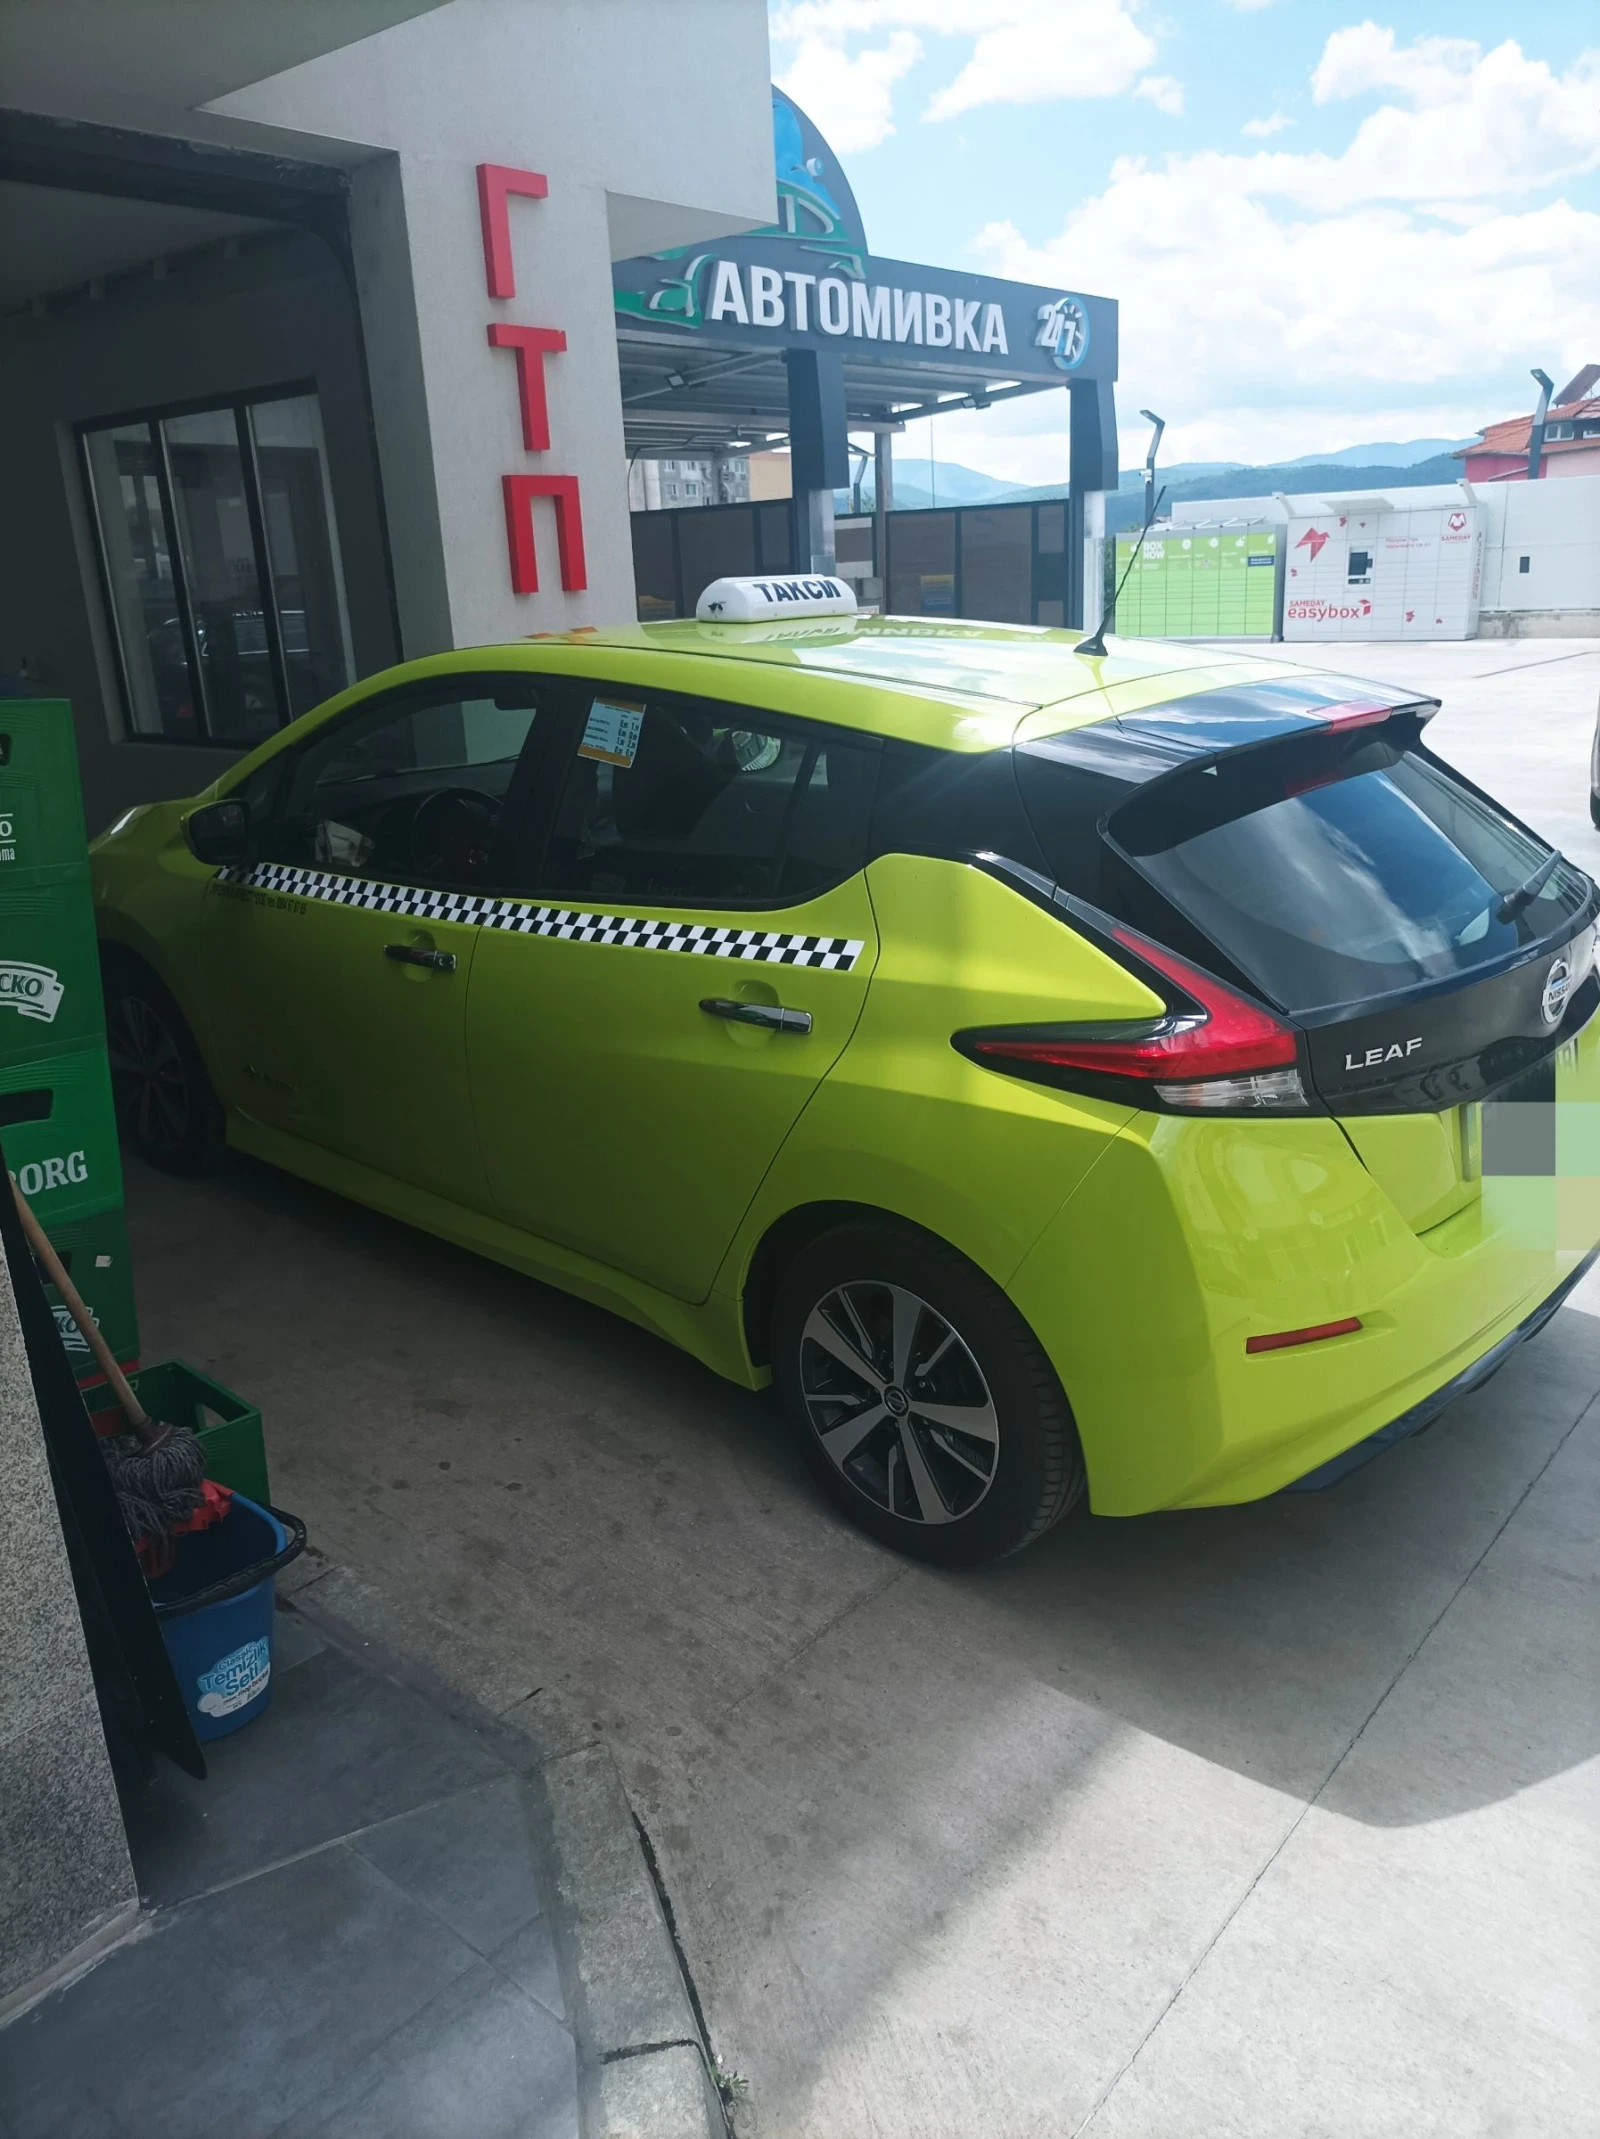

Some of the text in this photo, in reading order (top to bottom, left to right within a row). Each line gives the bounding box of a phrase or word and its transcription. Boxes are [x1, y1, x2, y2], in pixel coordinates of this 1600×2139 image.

[707, 260, 1009, 356] АВТОМИВКА
[476, 163, 587, 594] ГТП
[1143, 541, 1164, 551] BOX
[1143, 550, 1165, 560] NOW
[753, 579, 841, 602] ТАКСИ
[1288, 605, 1360, 622] easybox
[1344, 1036, 1423, 1071] LEAF
[218, 1644, 253, 1671] Classic
